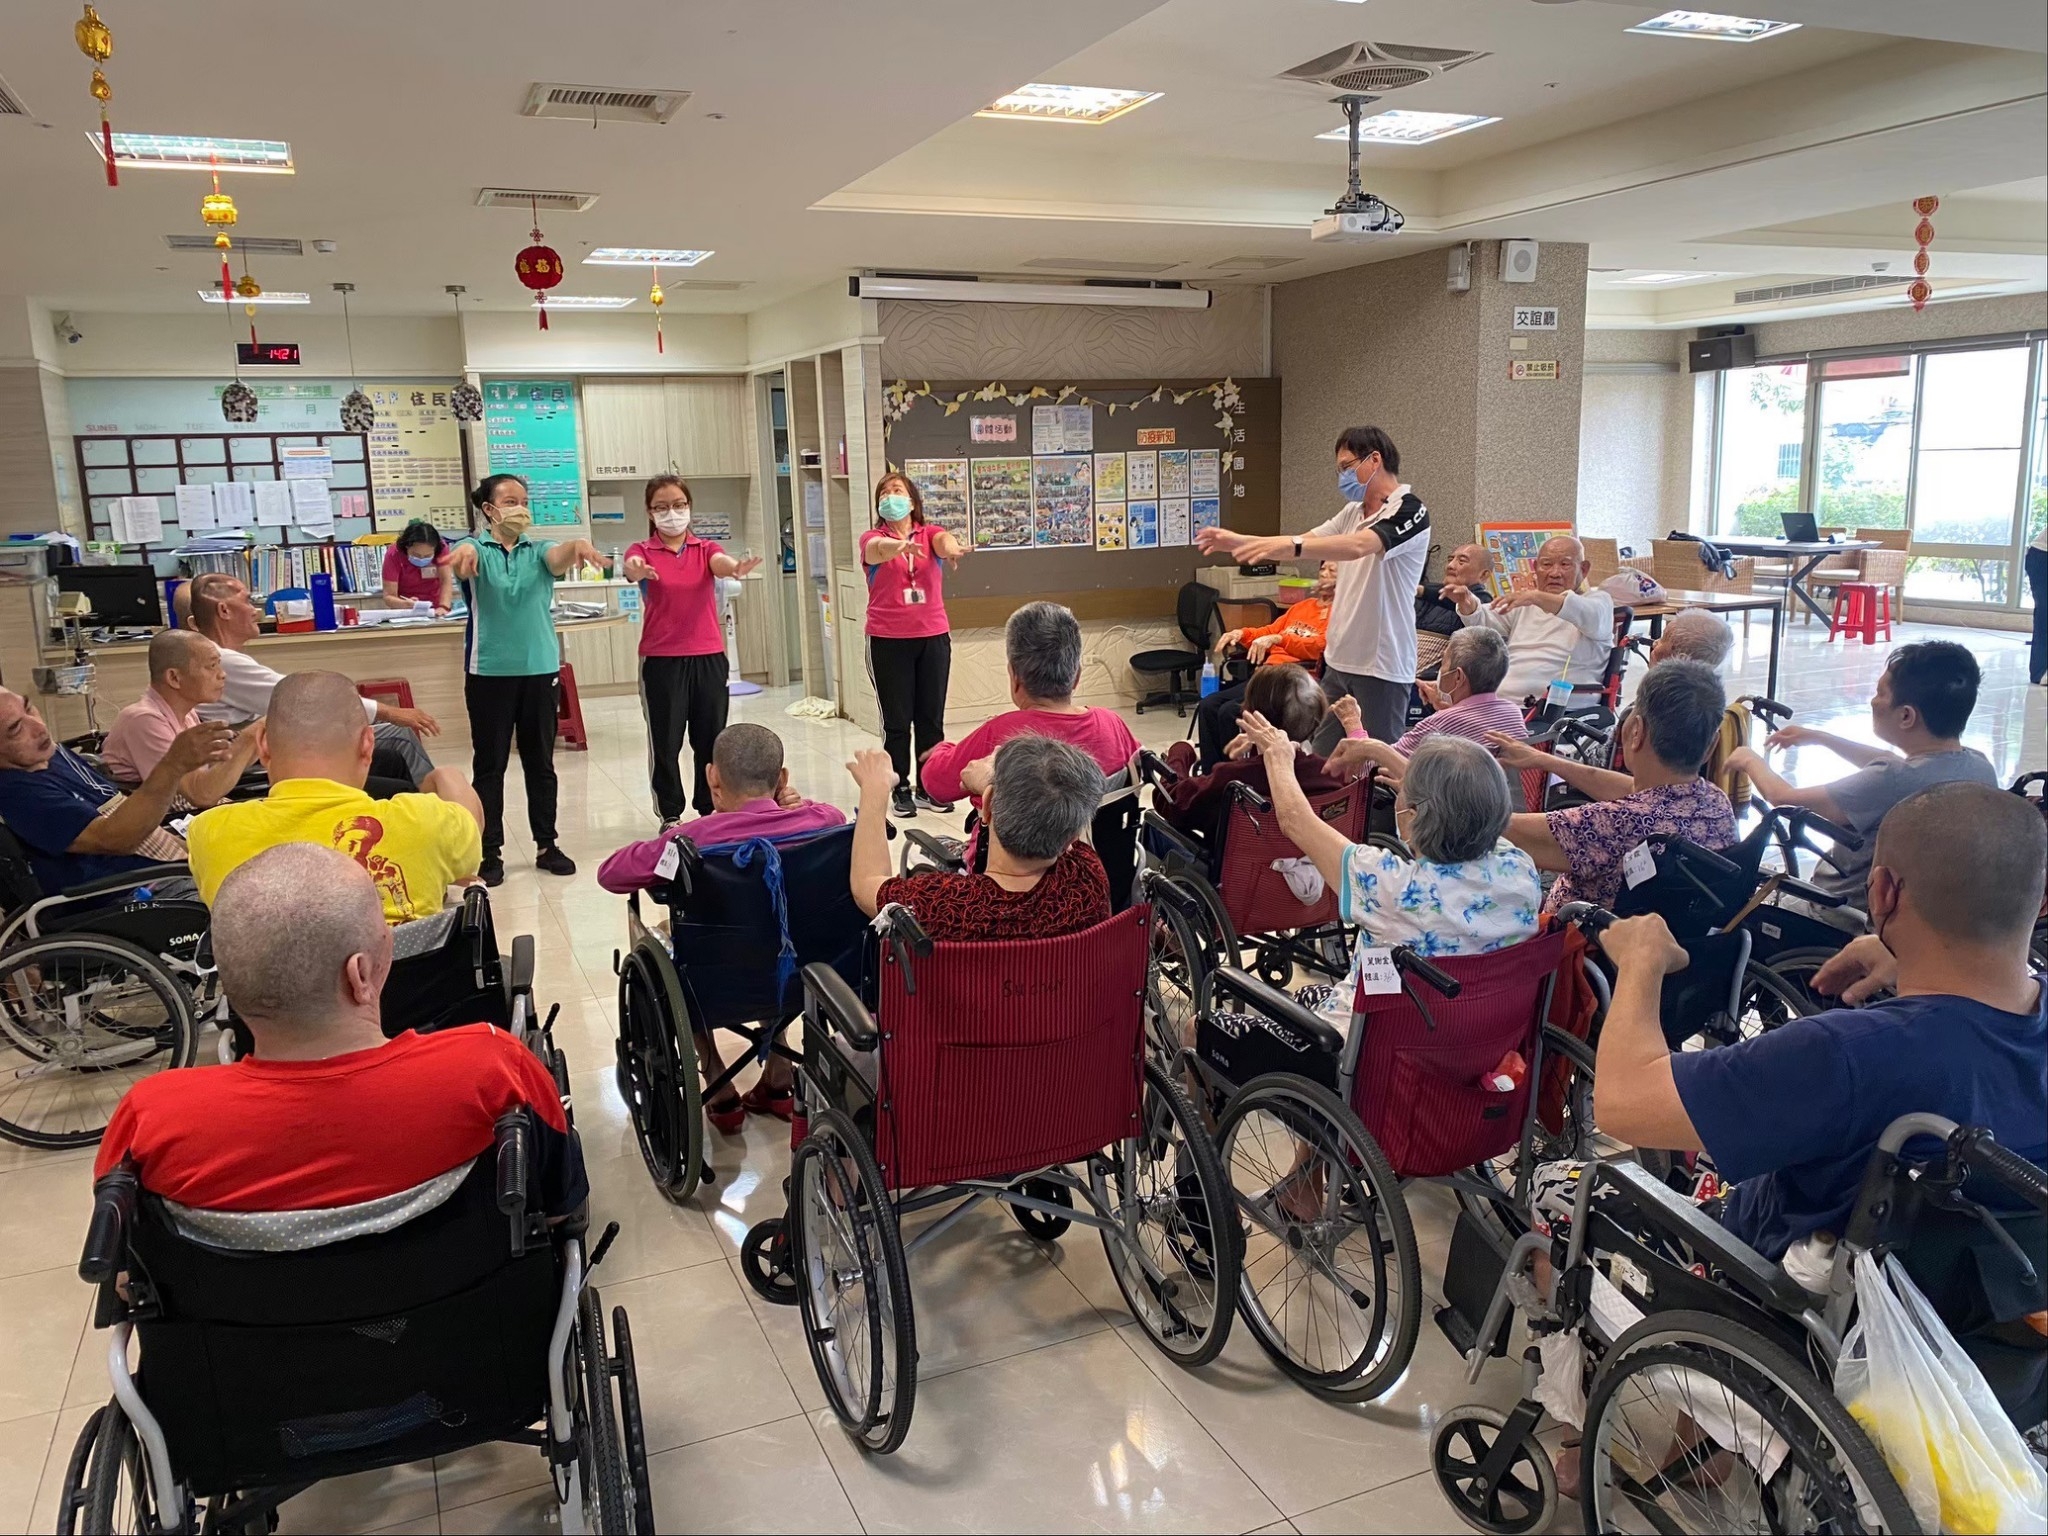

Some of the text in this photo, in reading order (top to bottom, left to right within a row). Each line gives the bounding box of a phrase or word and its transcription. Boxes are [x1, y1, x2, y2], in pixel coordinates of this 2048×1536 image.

[1516, 310, 1555, 326] 交誼廳
[305, 403, 316, 415] 月
[1138, 429, 1175, 444] 防疫新知
[168, 932, 200, 947] SOMA
